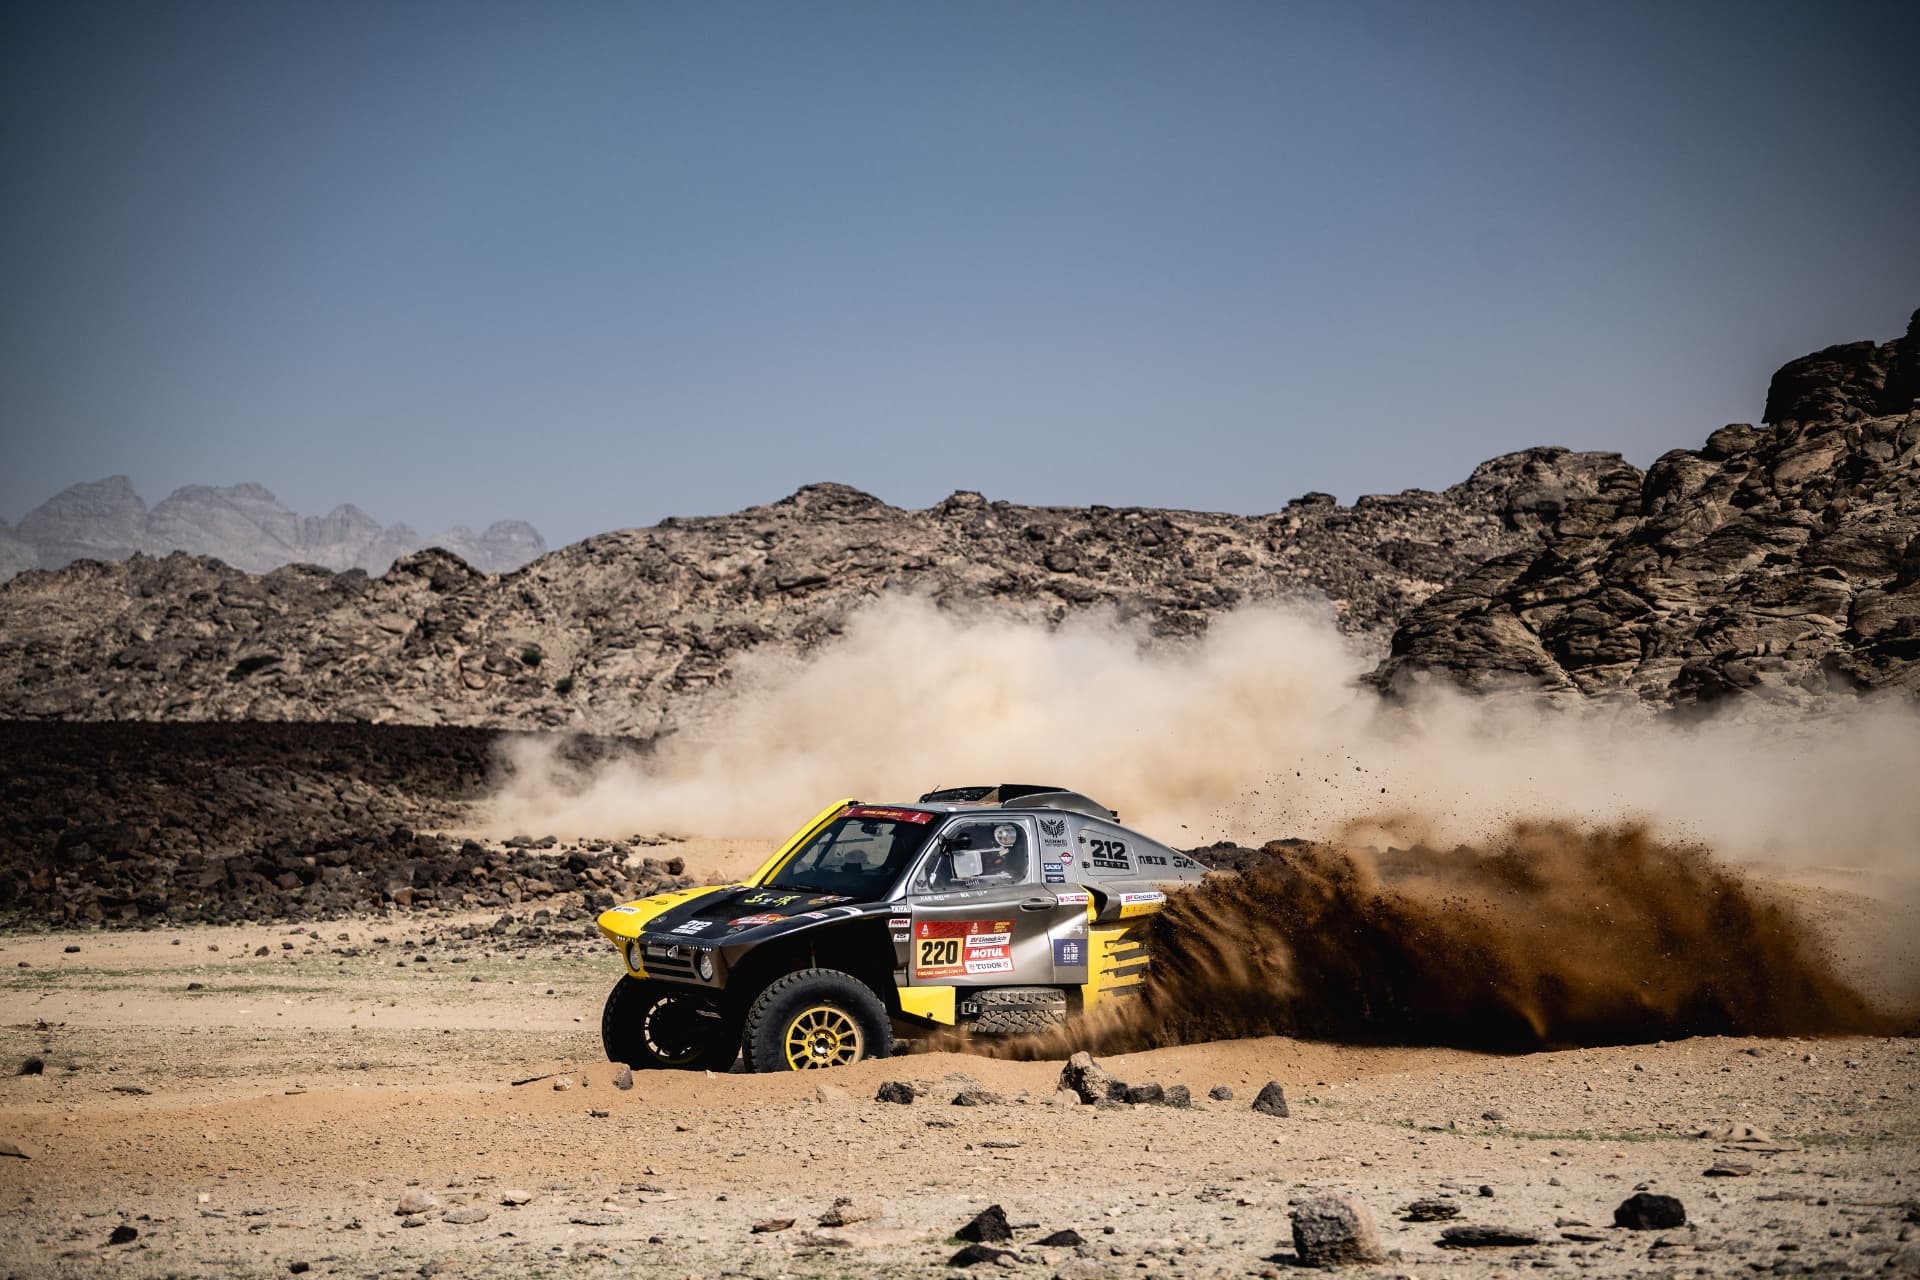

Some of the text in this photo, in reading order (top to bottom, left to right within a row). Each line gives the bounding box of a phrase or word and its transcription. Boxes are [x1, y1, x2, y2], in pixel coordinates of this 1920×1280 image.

[1090, 839, 1128, 861] 212
[921, 941, 958, 966] 220
[970, 947, 1004, 959] MOTUL
[976, 961, 1002, 970] TUDOR
